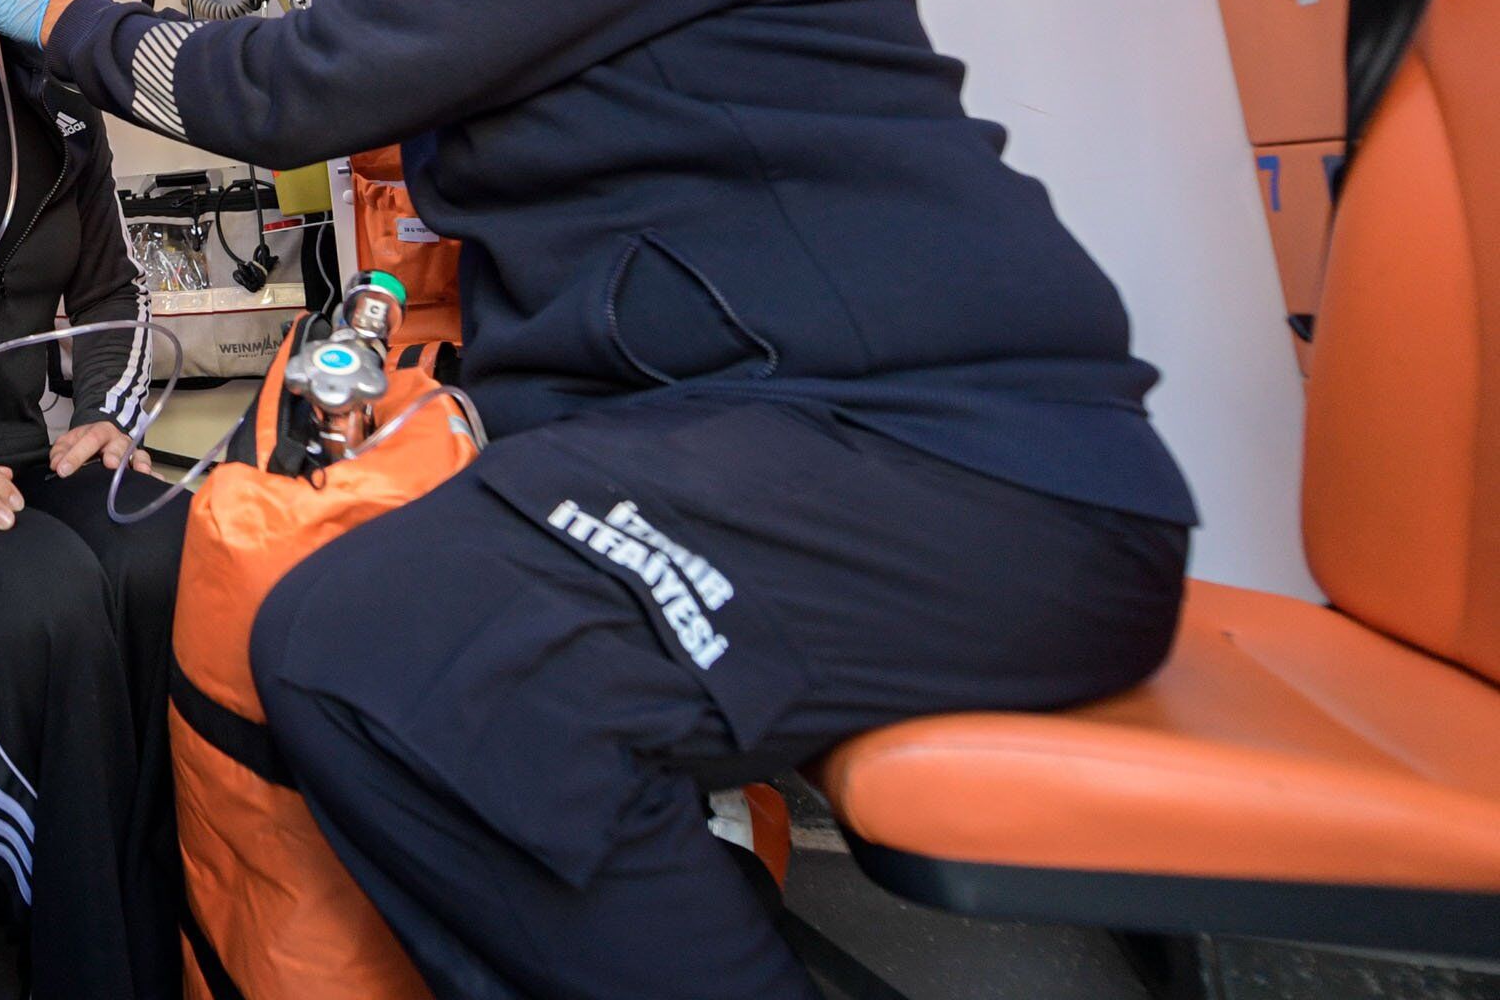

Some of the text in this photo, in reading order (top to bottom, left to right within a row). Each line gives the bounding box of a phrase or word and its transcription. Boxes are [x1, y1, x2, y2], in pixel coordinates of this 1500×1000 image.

[1257, 155, 1281, 212] 7
[219, 333, 281, 356] WEINMAN
[547, 499, 729, 671] İTFAİYESİ
